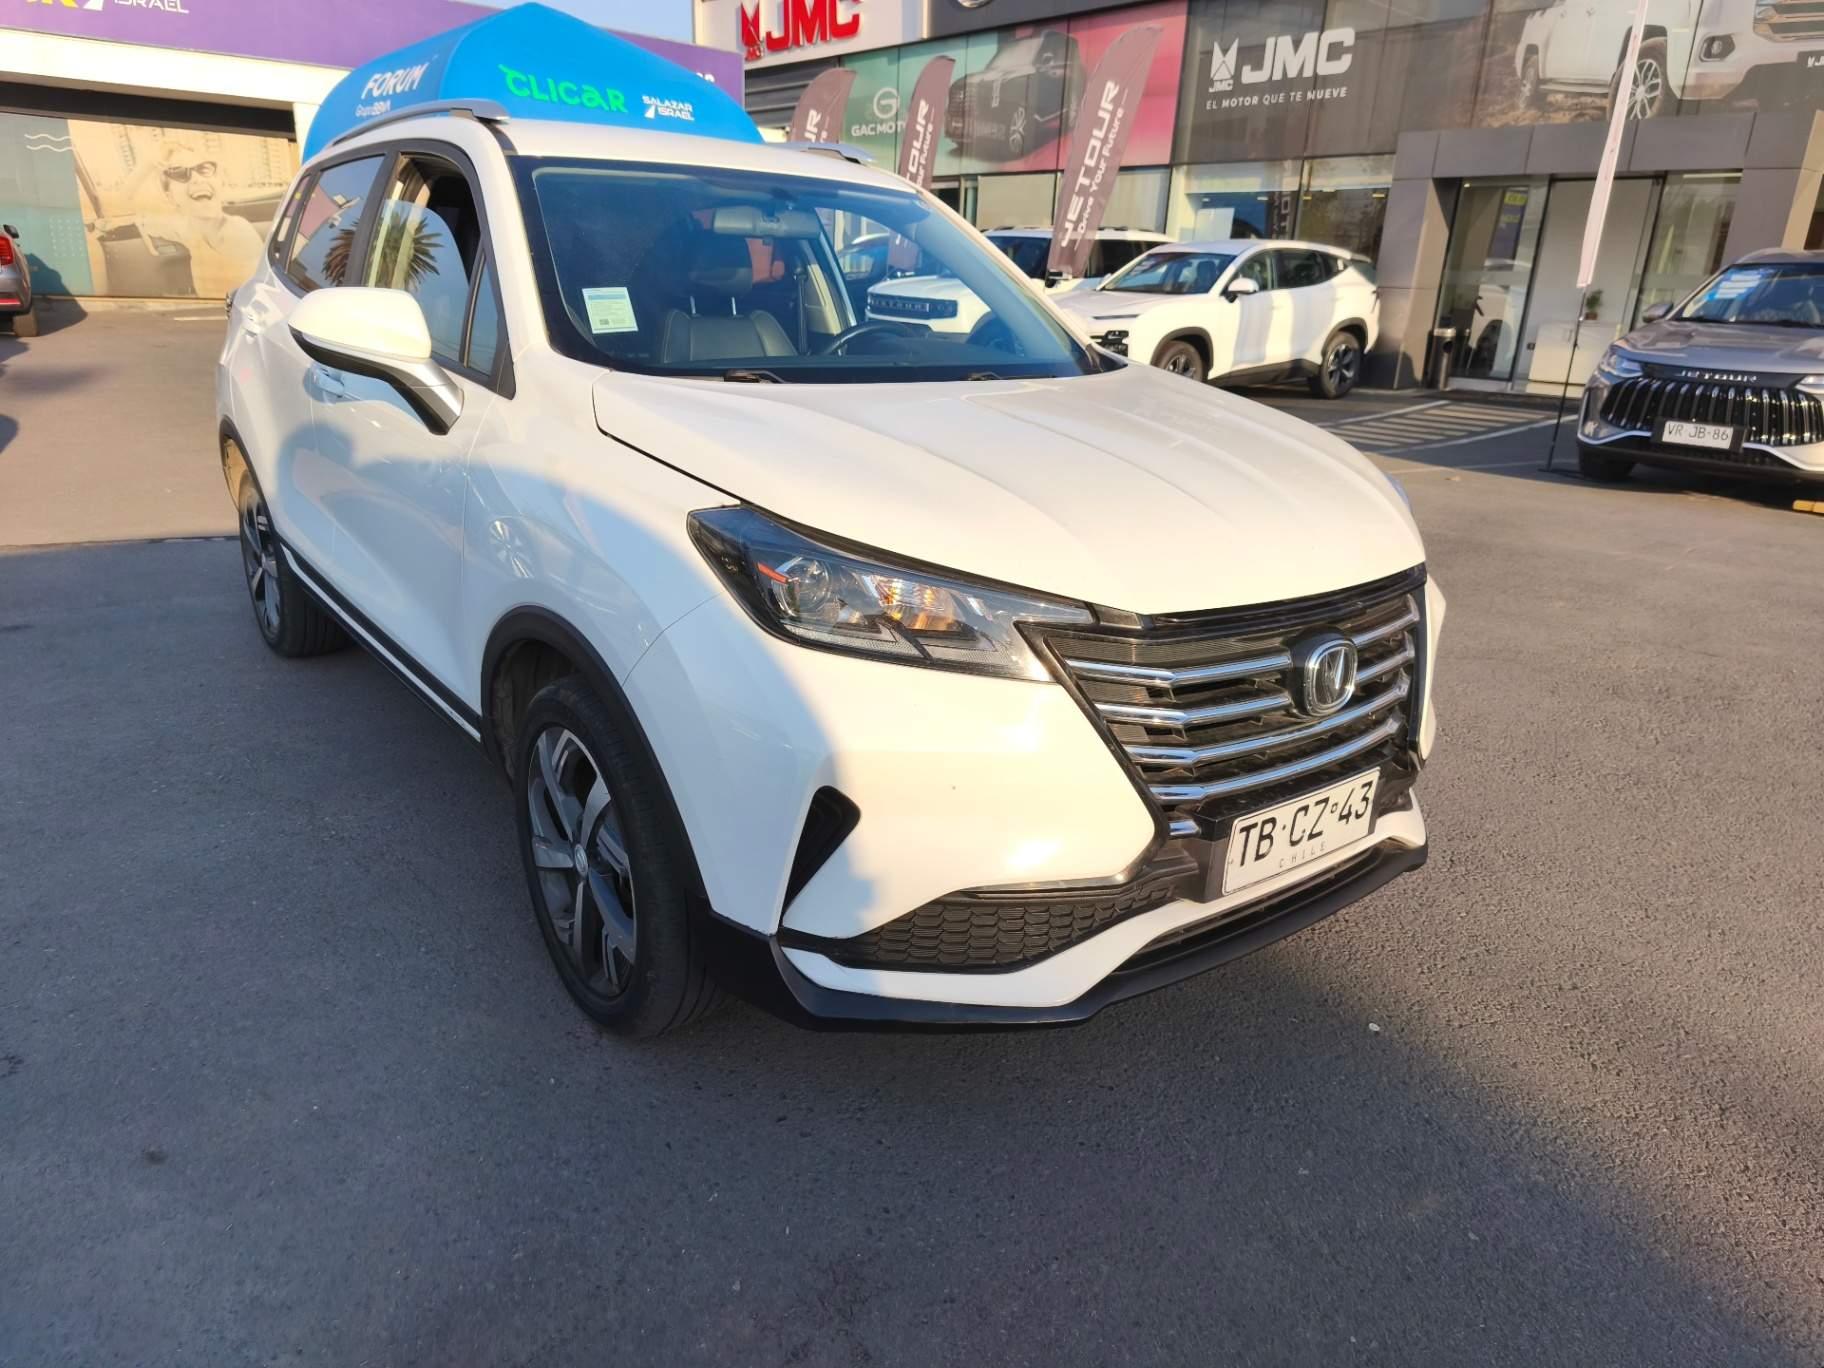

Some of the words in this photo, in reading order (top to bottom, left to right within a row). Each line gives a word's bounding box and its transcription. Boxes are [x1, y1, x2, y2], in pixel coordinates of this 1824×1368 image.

[765, 0, 861, 52] JMC
[1241, 27, 1355, 84] JMC
[360, 62, 430, 100] FORUM
[641, 95, 694, 112] SALAZAR
[1206, 100, 1217, 110] EL
[1221, 95, 1259, 108] MOTOR
[1263, 93, 1285, 105] QUE
[1290, 91, 1303, 102] TE
[1061, 80, 1120, 247] JETOUR
[1090, 157, 1107, 192] Your
[1102, 107, 1125, 157] Future
[1279, 841, 1325, 869] CHILE
